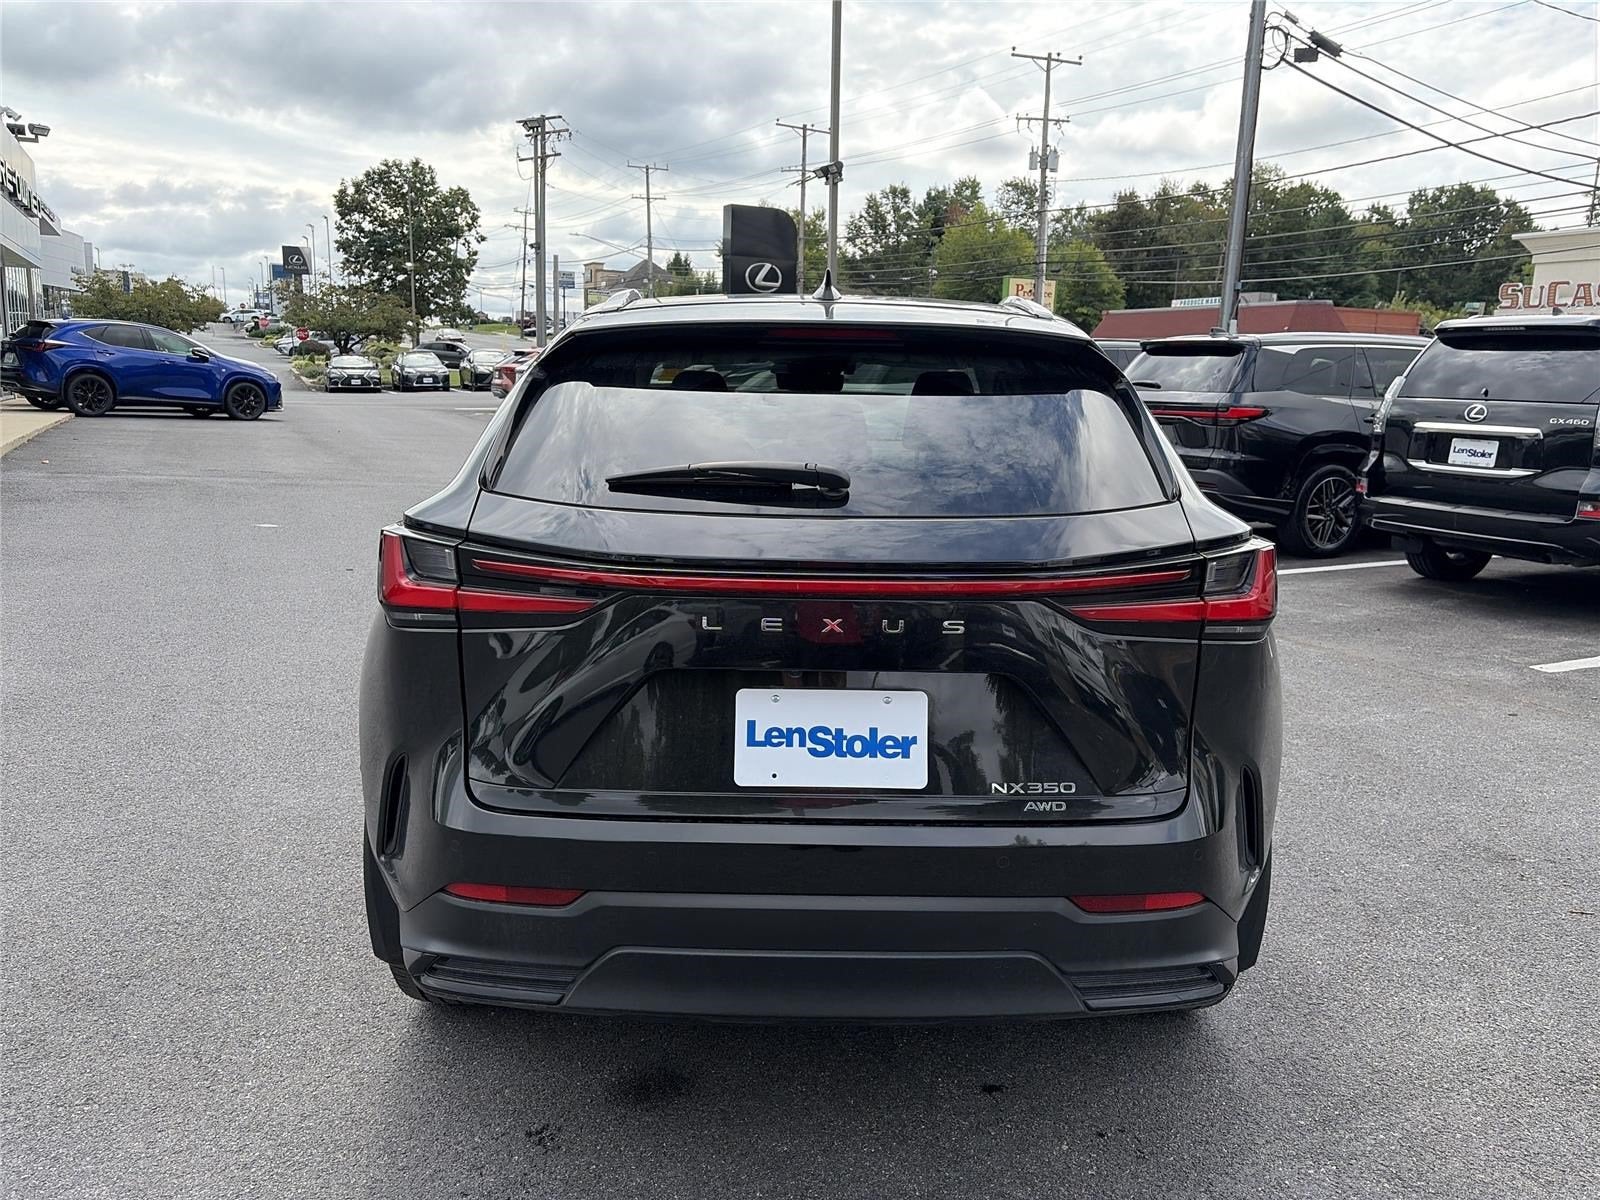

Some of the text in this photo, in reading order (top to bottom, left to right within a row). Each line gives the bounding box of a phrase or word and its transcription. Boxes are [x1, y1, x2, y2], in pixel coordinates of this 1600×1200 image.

[1016, 283, 1053, 298] Proce
[1498, 281, 1600, 309] SUCA
[1549, 417, 1590, 426] GX460
[1453, 446, 1494, 459] LenStoler
[701, 616, 965, 635] LEXUS
[991, 782, 1076, 794] NX350
[1023, 801, 1067, 812] AWD
